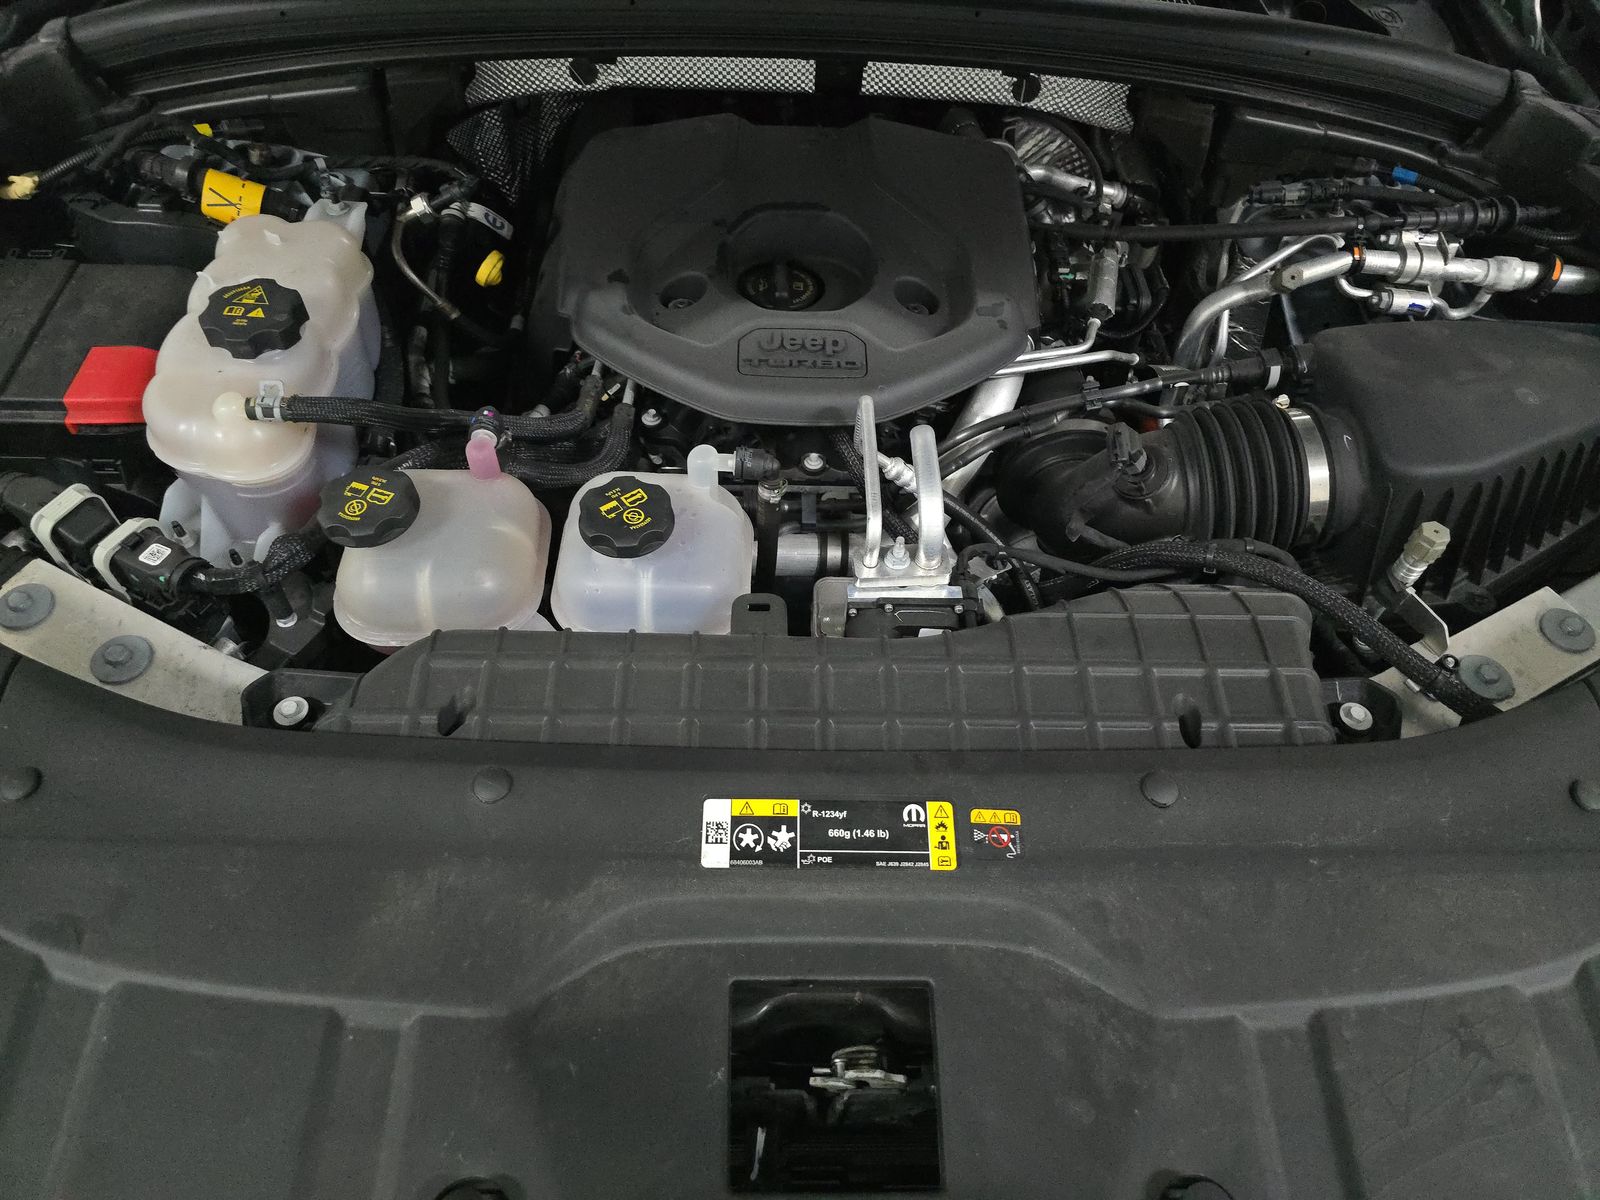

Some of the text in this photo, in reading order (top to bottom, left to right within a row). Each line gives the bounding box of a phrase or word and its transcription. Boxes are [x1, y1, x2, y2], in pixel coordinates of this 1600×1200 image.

[759, 331, 848, 357] Jeep
[742, 358, 862, 370] TURBO
[812, 810, 847, 819] R-1234yf
[828, 829, 889, 839] 660g (1.46 lb)
